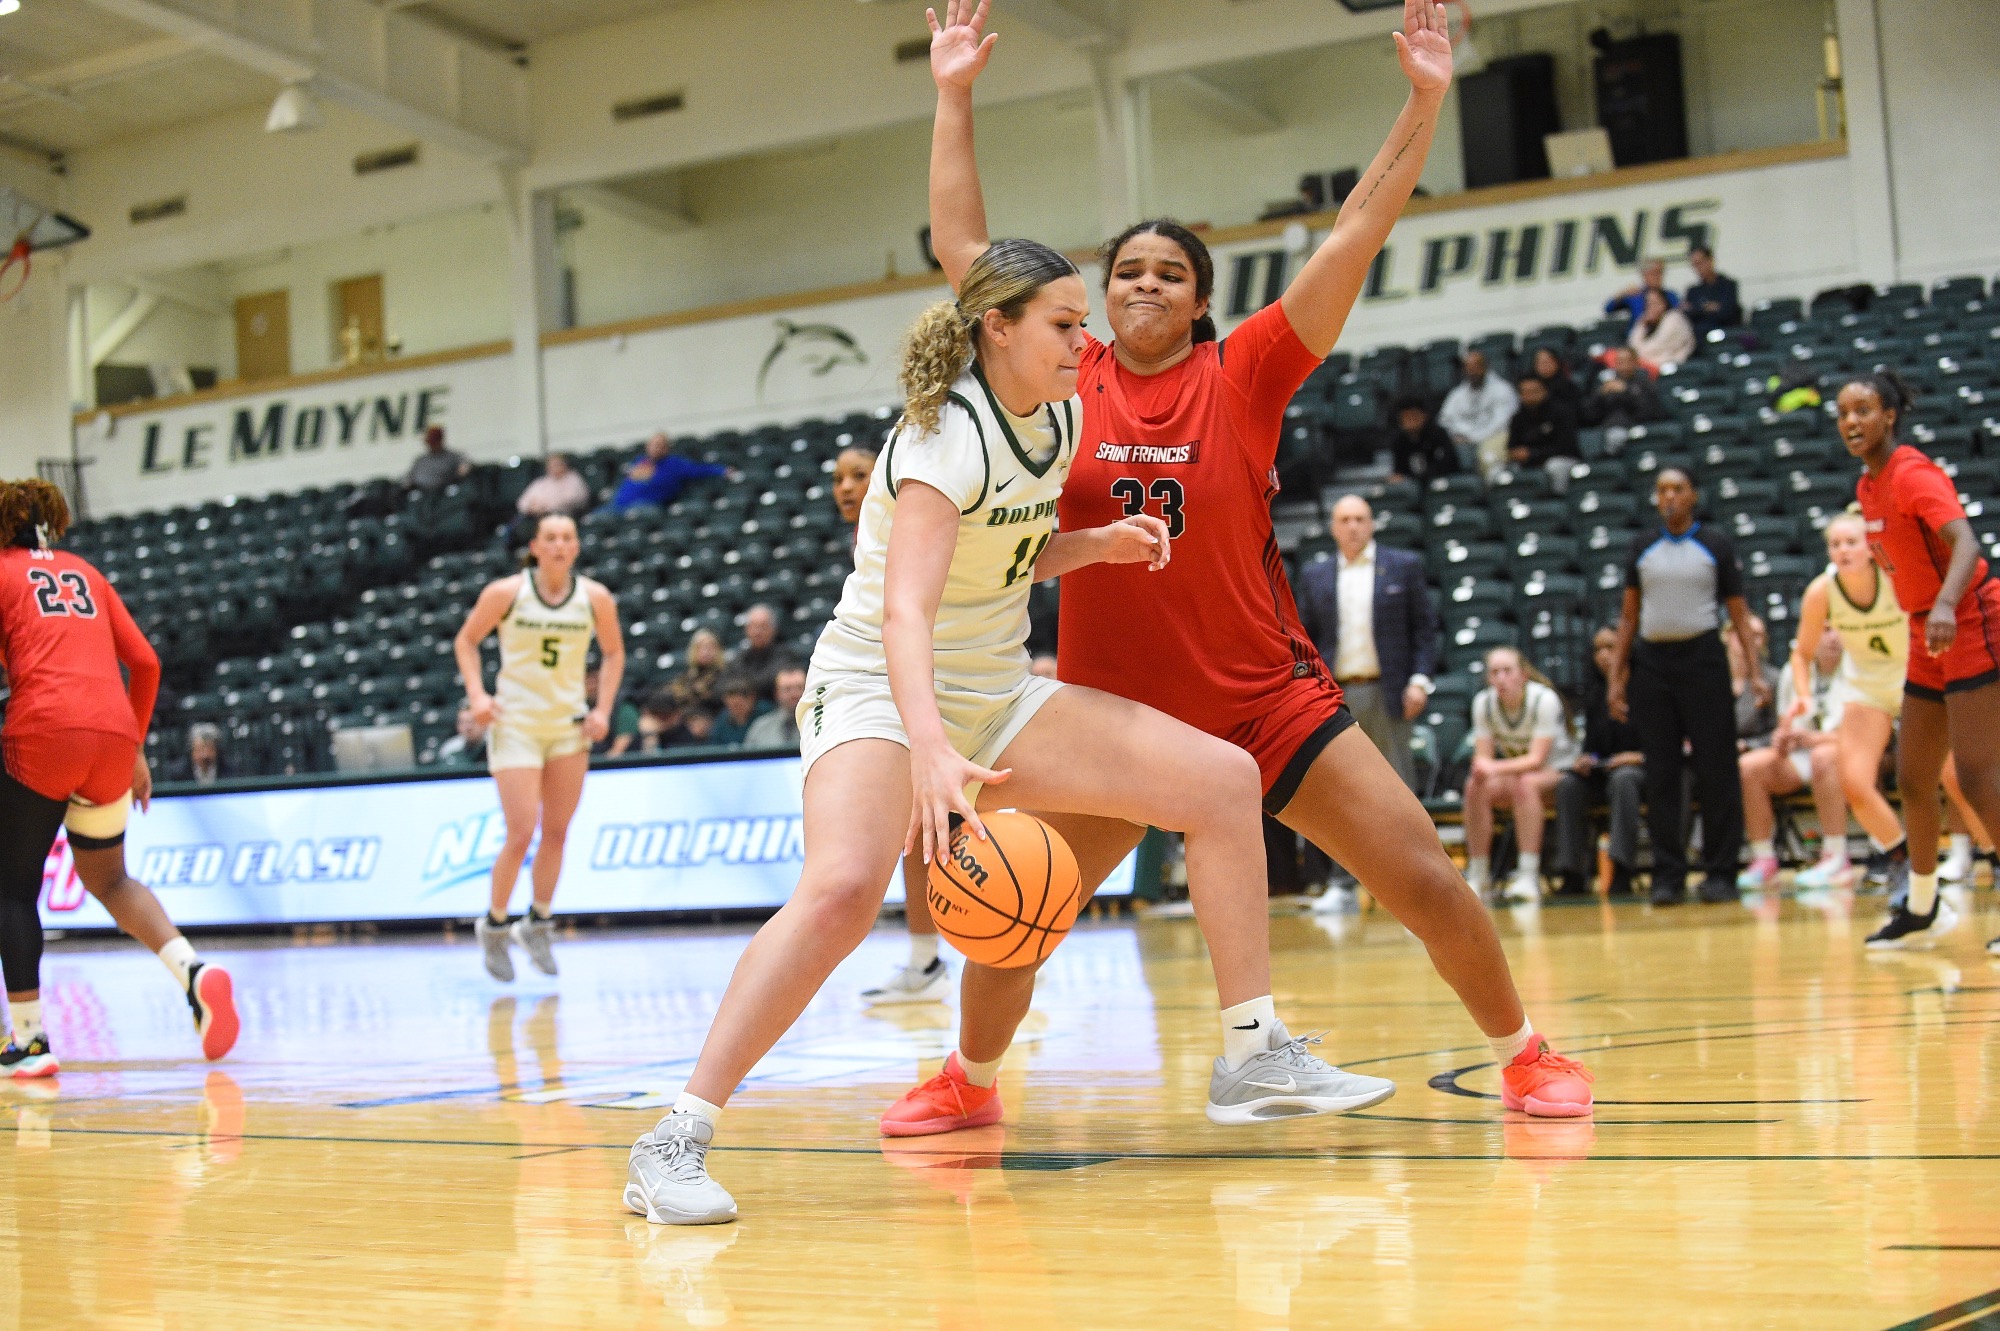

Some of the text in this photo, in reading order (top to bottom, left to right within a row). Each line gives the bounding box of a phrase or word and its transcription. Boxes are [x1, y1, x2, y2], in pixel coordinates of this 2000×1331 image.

[1226, 199, 1721, 321] DLPHINS
[1094, 441, 1133, 463] SAINT
[1130, 443, 1191, 465] FRANCIS
[986, 498, 1057, 527] DOLPH
[1110, 477, 1185, 539] 33
[27, 567, 98, 619] 23
[541, 635, 561, 669] 5
[138, 836, 383, 888] RED FLASH
[421, 807, 508, 881] NE
[928, 881, 970, 917] VO NXT
